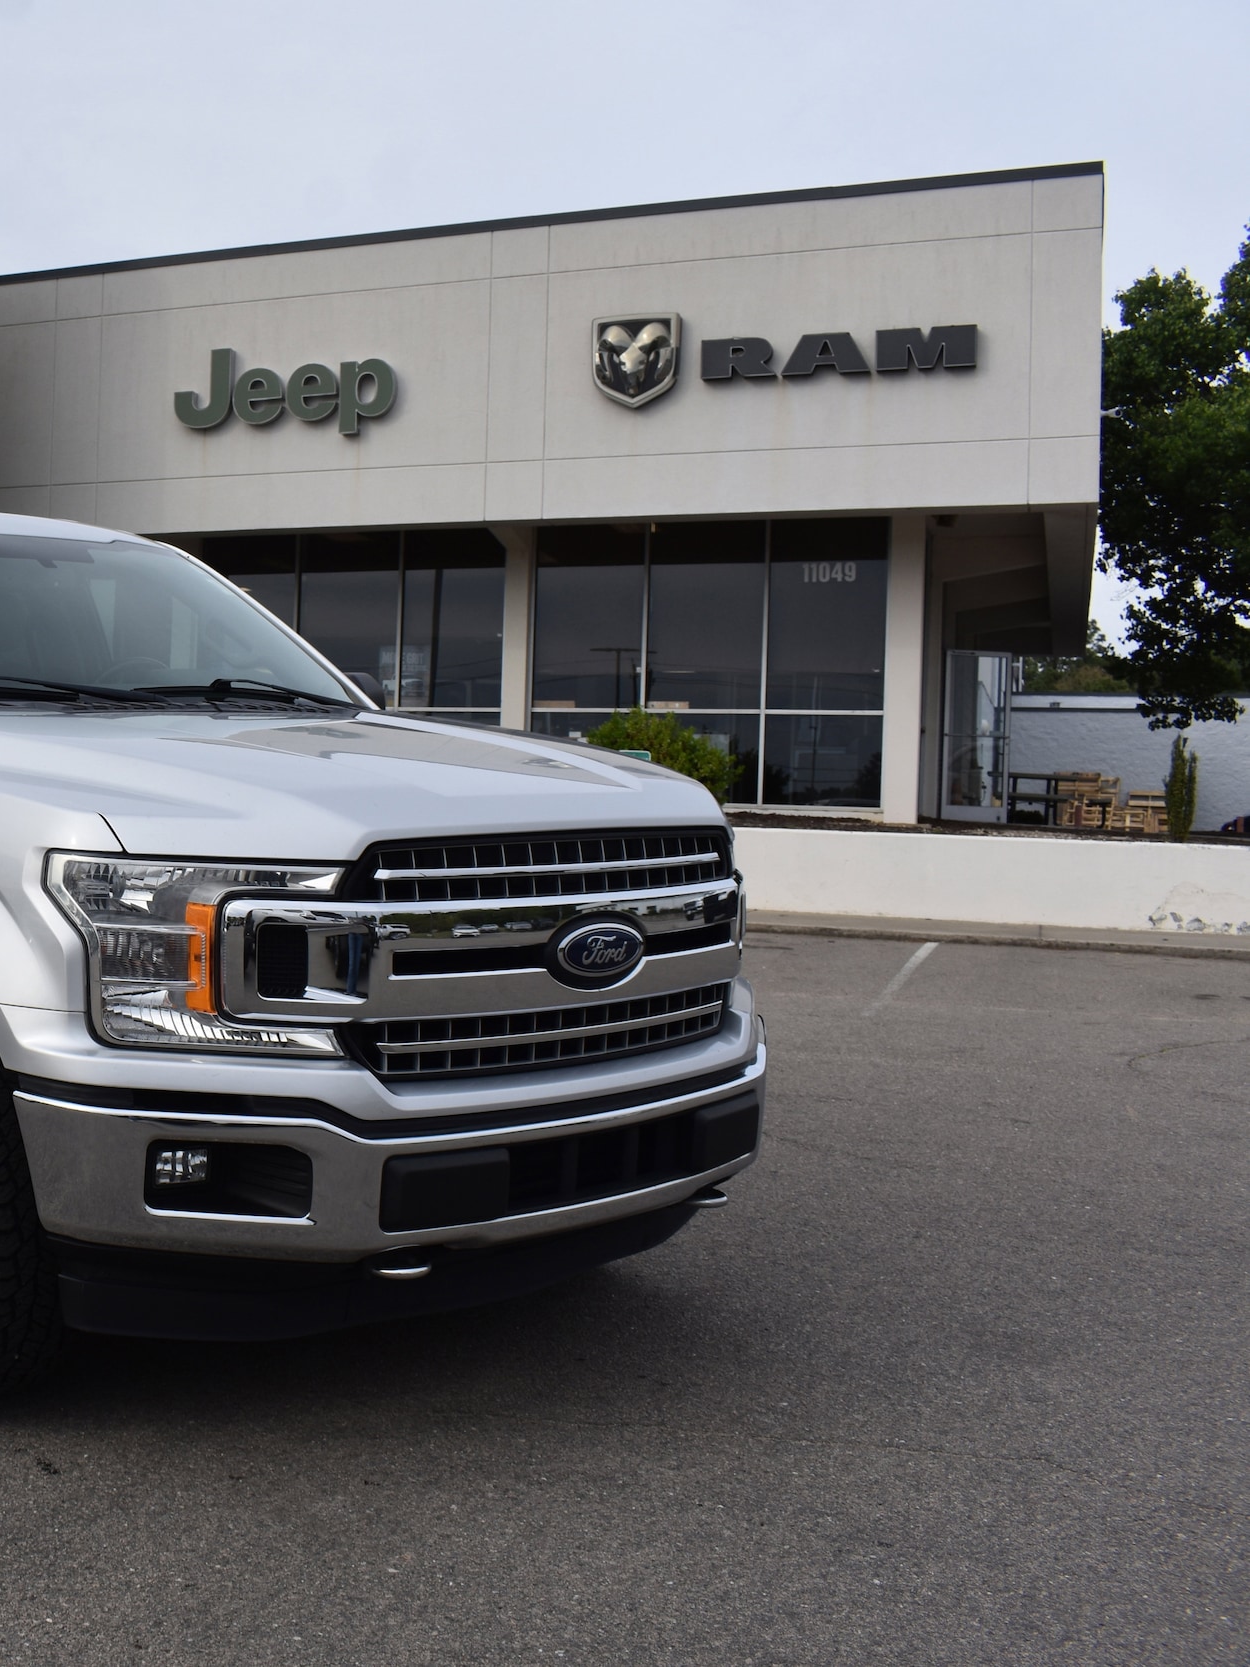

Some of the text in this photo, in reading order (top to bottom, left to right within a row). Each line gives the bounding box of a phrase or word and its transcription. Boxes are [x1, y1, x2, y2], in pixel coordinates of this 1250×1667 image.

[701, 324, 979, 381] RAM
[174, 347, 398, 435] Jeep
[802, 561, 856, 583] 11049
[582, 935, 627, 965] Ford
